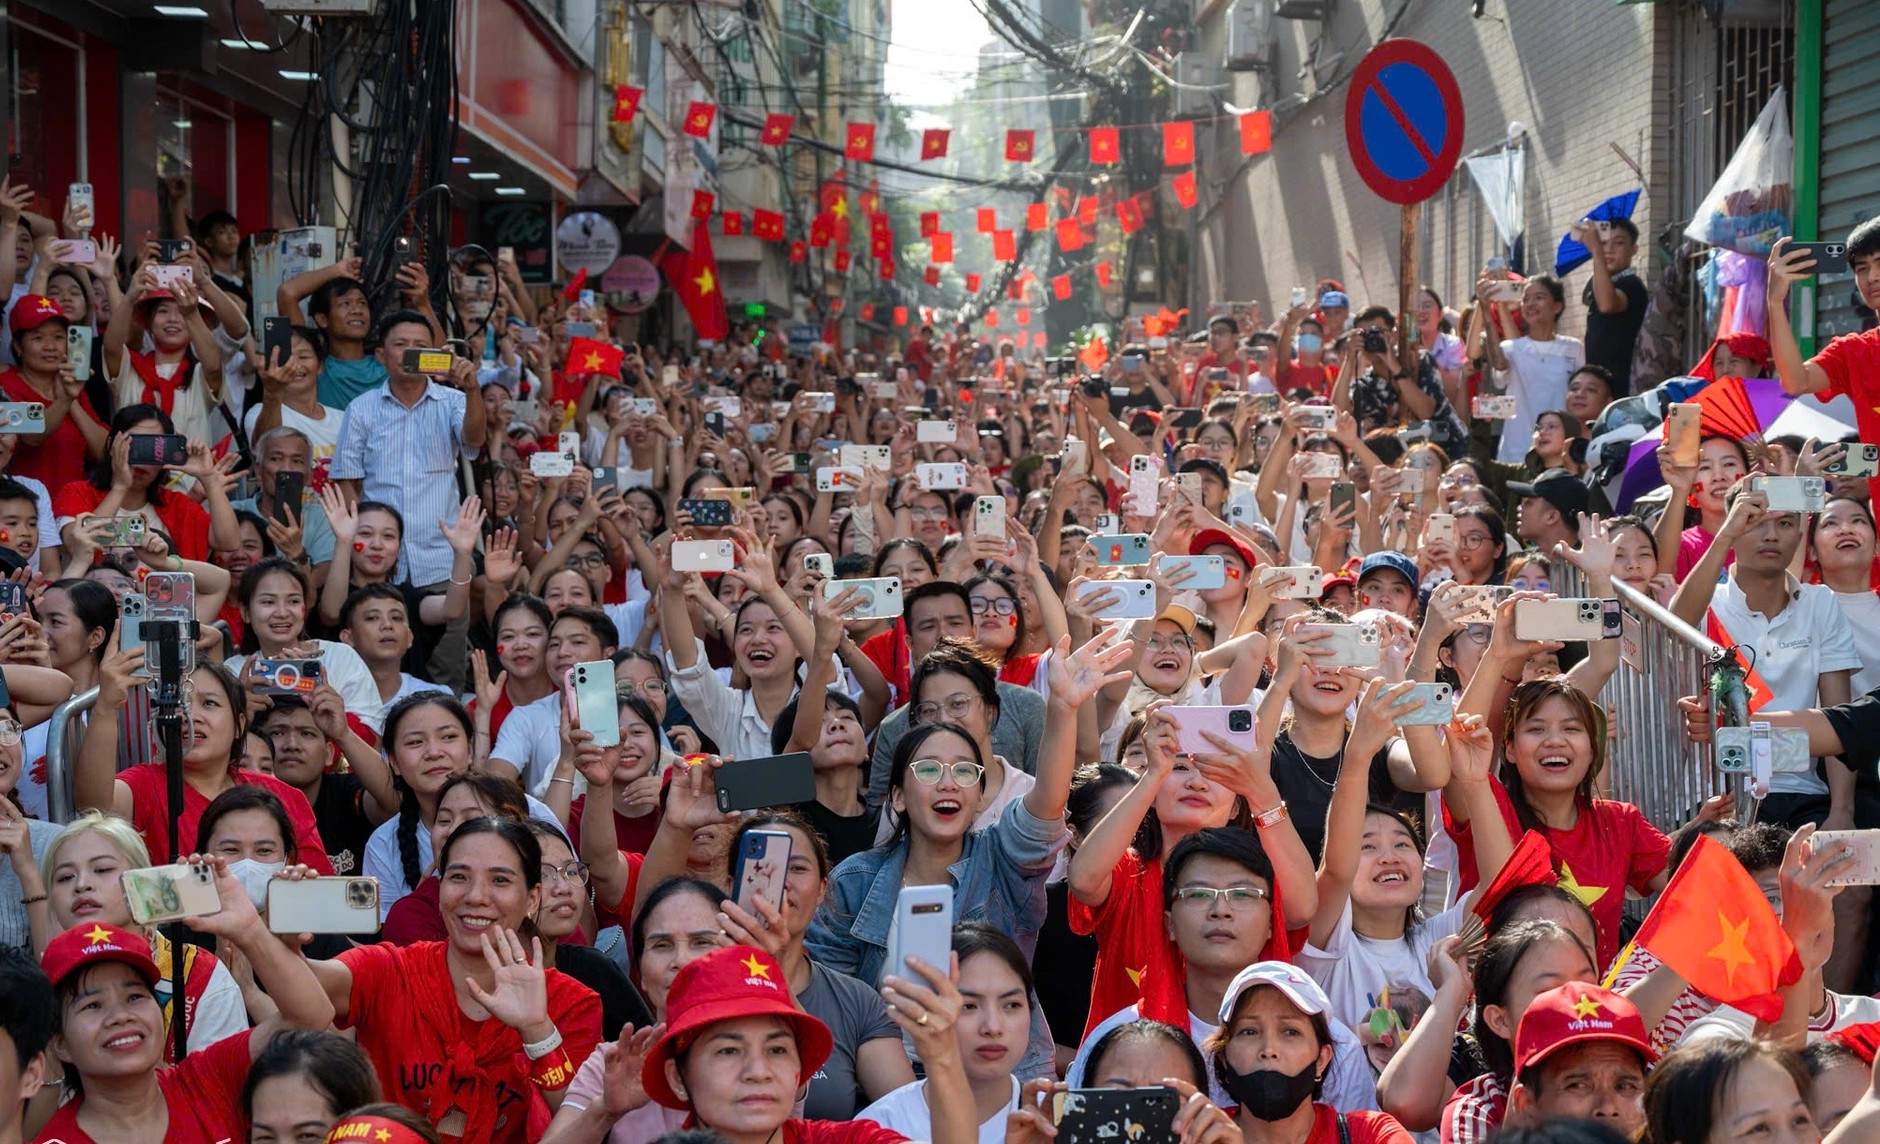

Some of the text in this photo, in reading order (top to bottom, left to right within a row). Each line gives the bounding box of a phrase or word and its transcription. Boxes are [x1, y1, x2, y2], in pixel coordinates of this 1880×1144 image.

[1623, 636, 1637, 656] STOP
[82, 944, 103, 955] Việt
[1568, 1020, 1613, 1031] Việt Nam
[542, 1067, 565, 1087] YÊU
[333, 1122, 373, 1141] NAM
